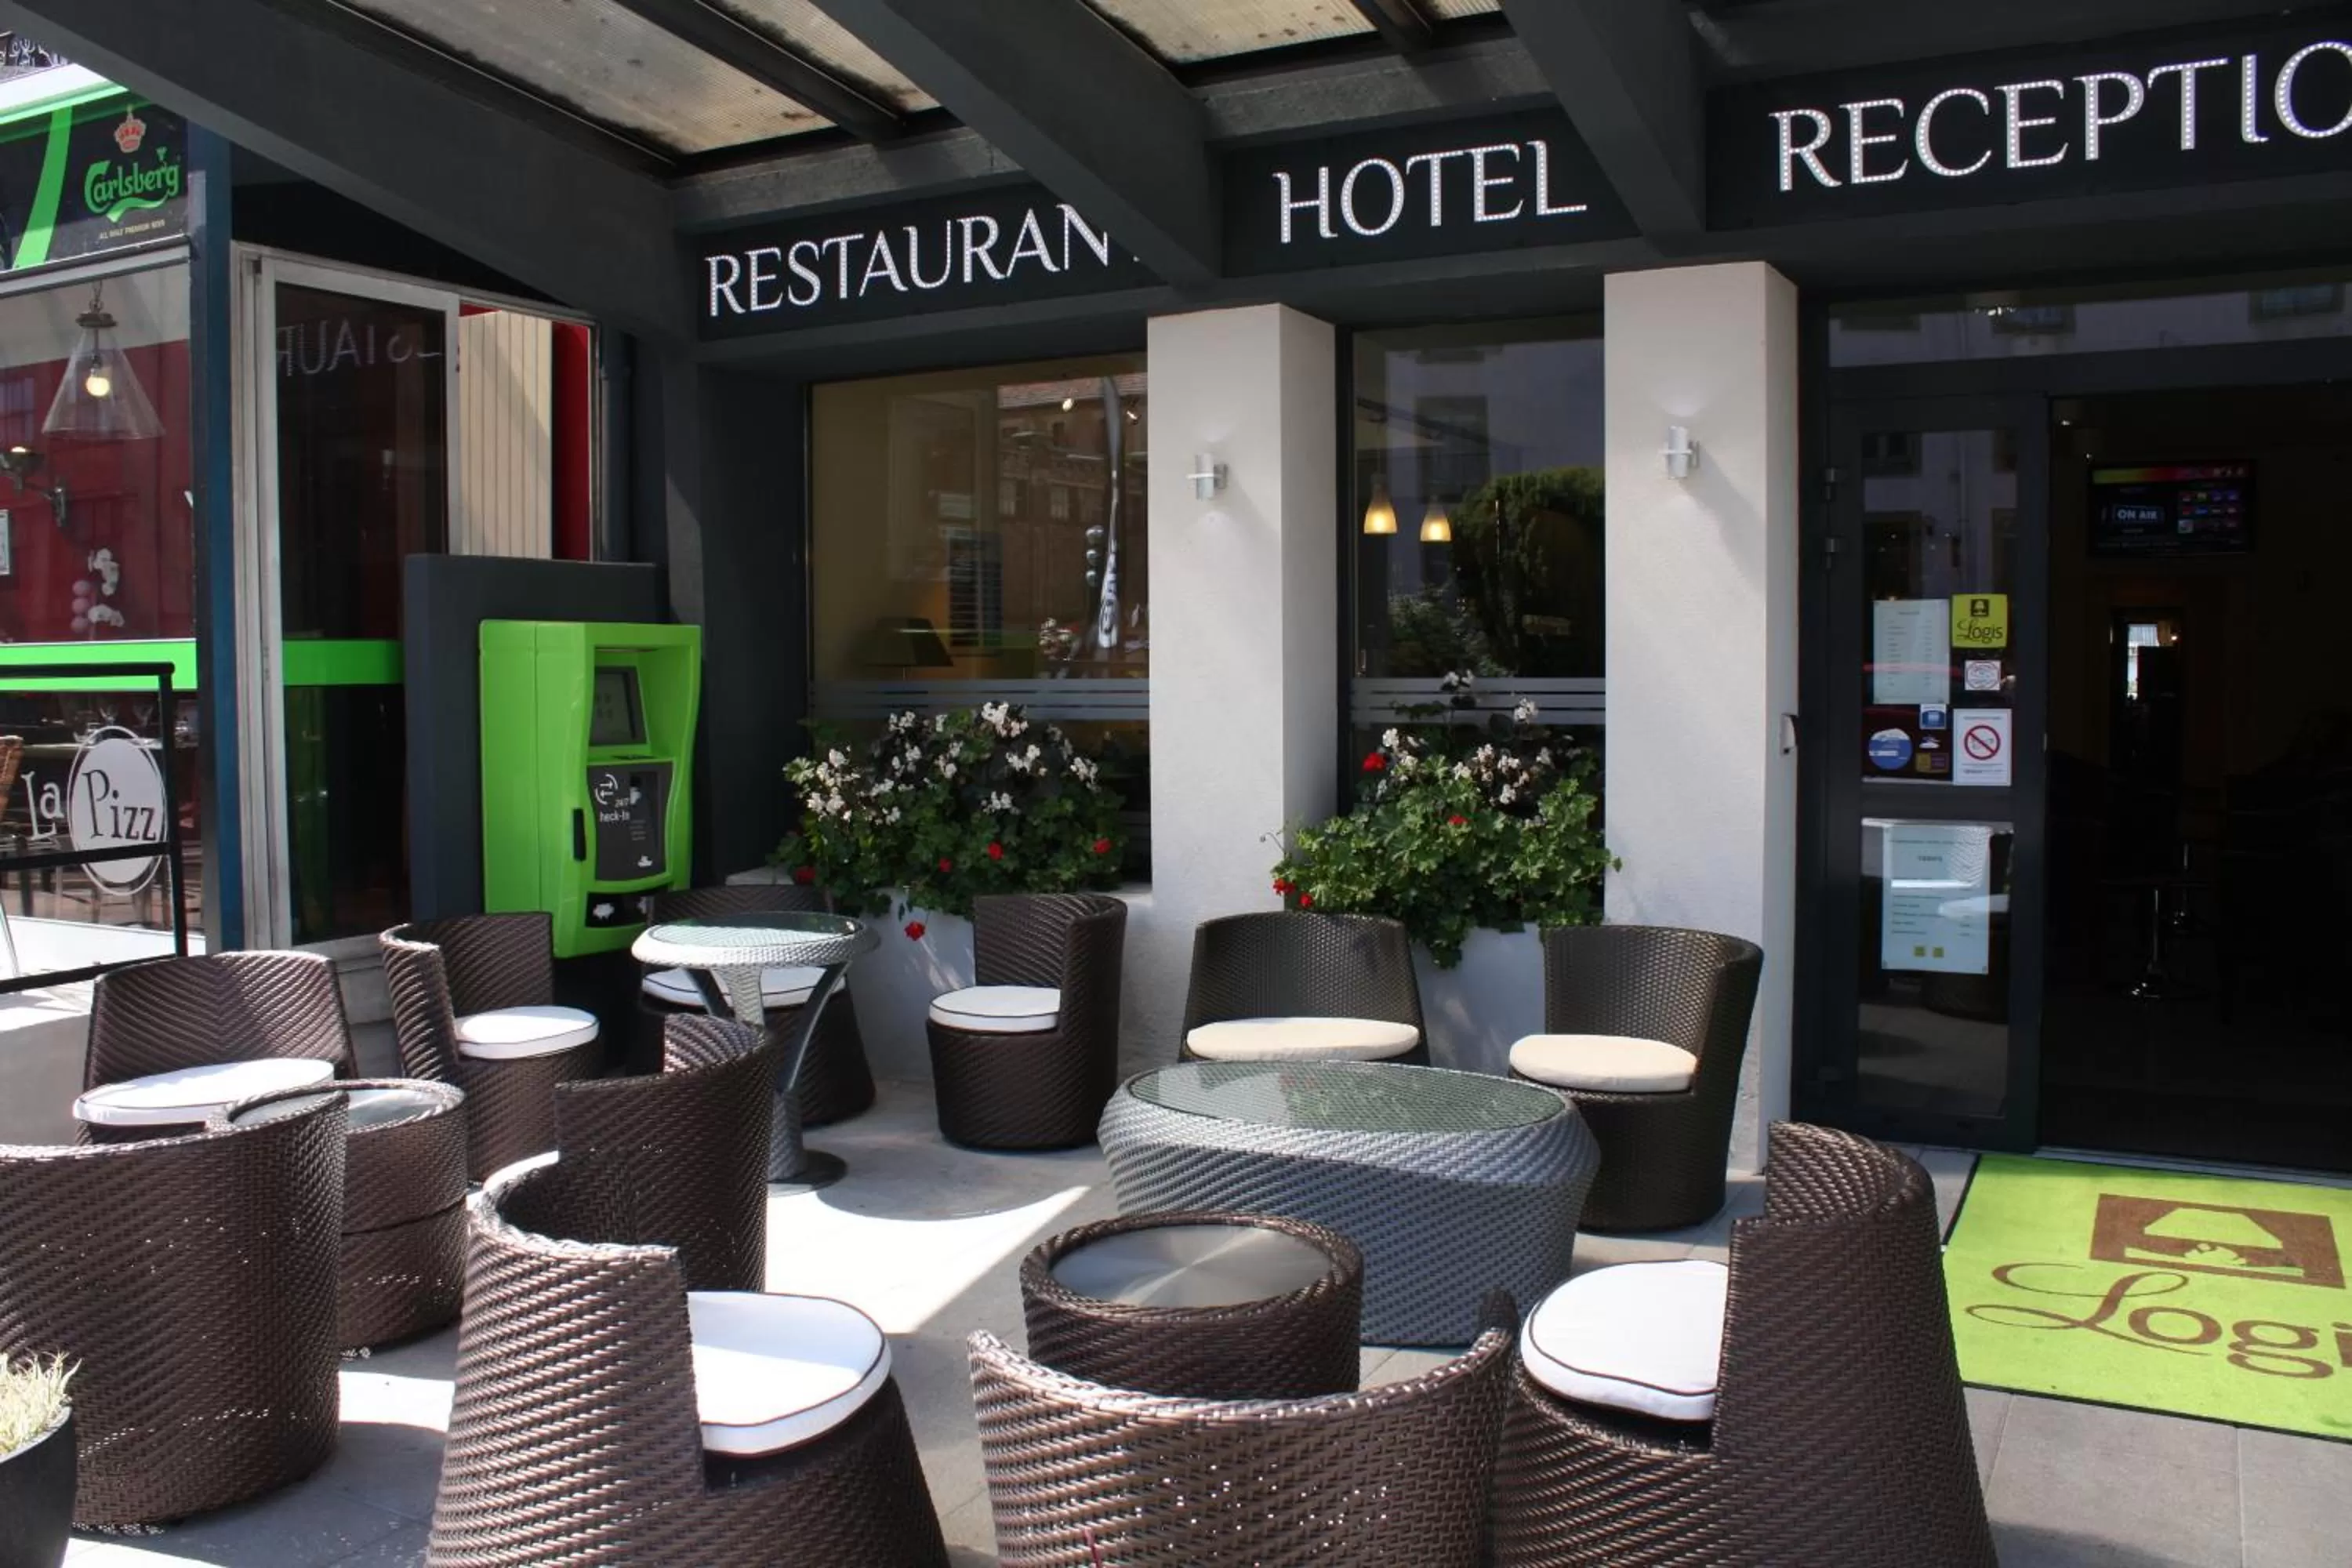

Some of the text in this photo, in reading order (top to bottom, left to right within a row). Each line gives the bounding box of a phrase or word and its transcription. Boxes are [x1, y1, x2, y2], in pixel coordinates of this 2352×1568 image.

[1767, 40, 2352, 192] RECEPTIO
[84, 147, 182, 216] Carlsberg
[1271, 140, 1588, 244] HOTEL
[703, 203, 1140, 318] RESTAURAN
[2116, 508, 2158, 520] ON AIR
[1956, 618, 2004, 644] Logis
[21, 769, 157, 841] La Pizz
